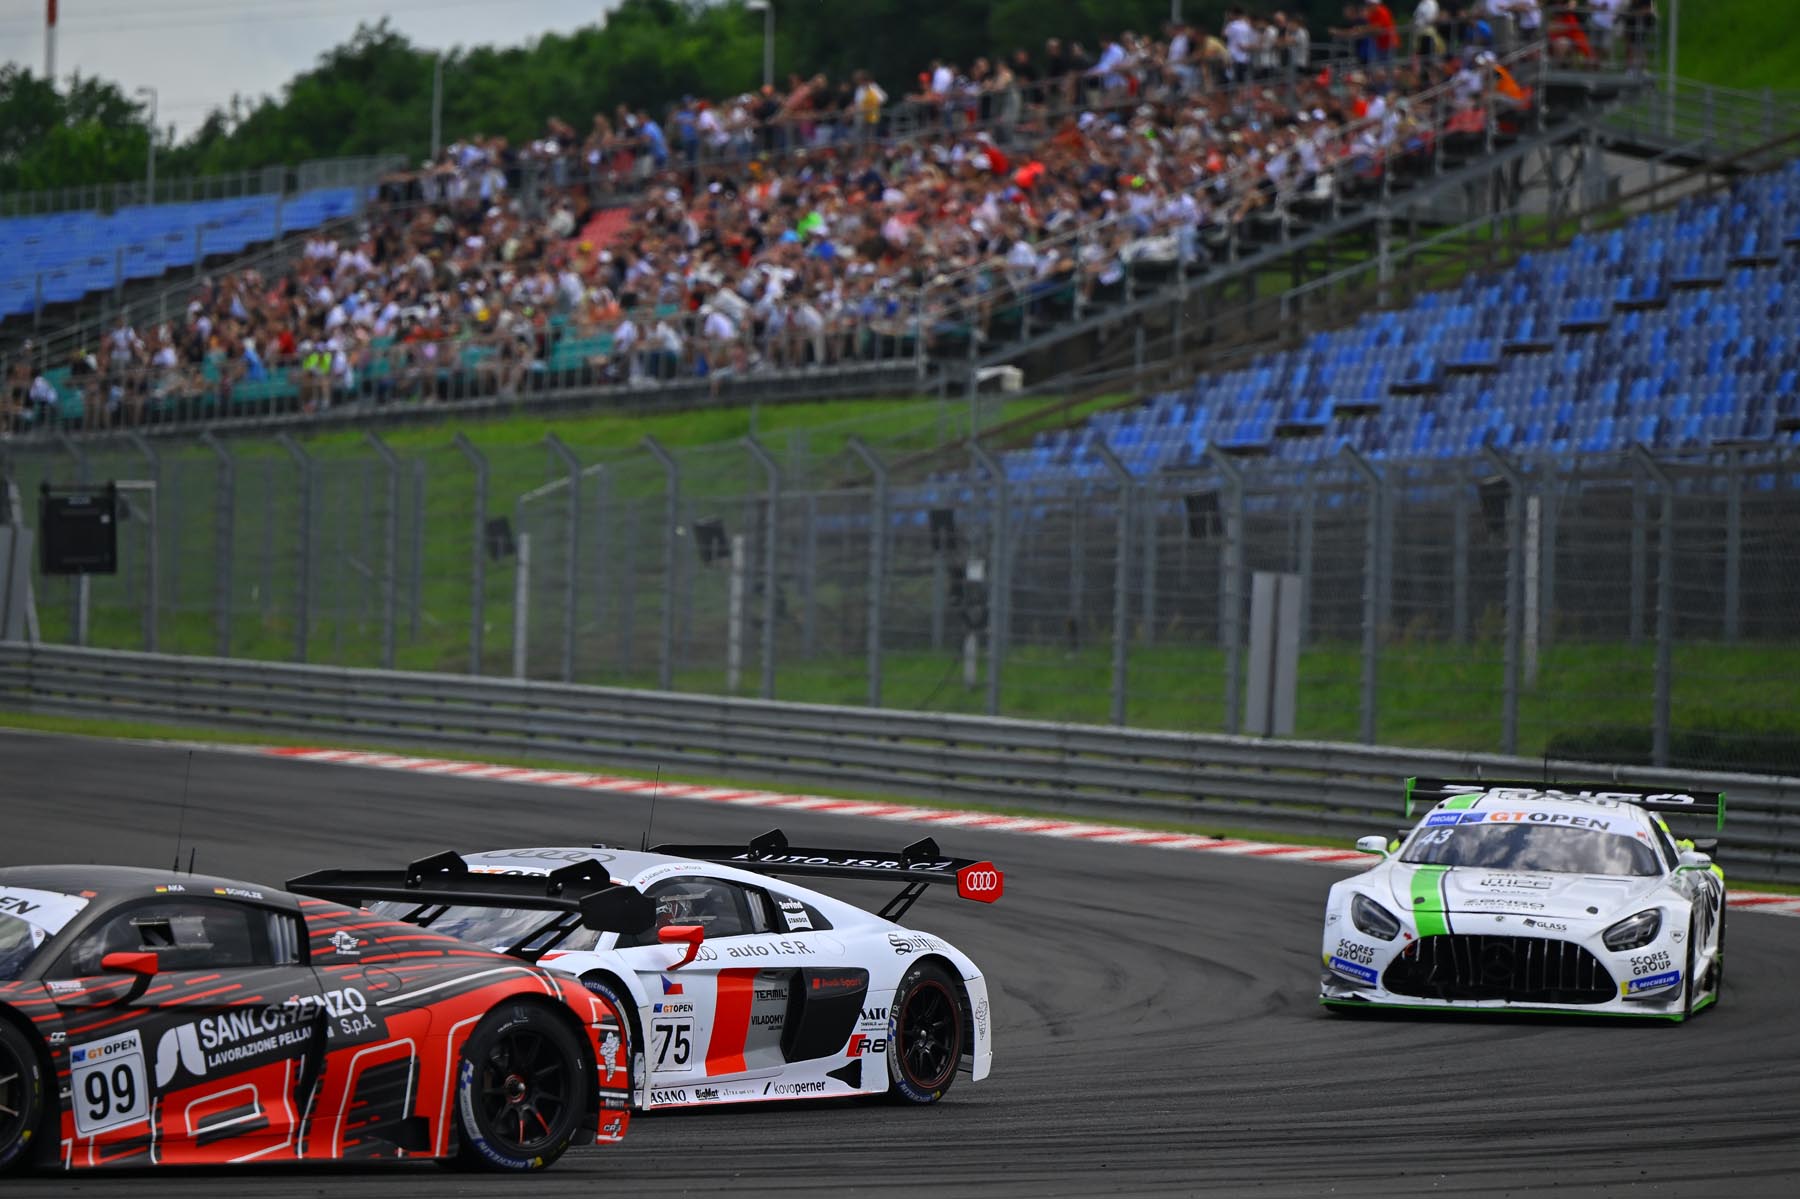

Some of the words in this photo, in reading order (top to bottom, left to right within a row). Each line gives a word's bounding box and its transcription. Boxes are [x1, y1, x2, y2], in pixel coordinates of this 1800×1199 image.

[1536, 921, 1567, 931] GLASS
[727, 944, 769, 958] auto
[770, 940, 816, 955] I.S.R.
[1338, 938, 1375, 956] SCORES
[1336, 948, 1373, 966] GROUP
[1630, 950, 1670, 966] SCORES
[1336, 963, 1372, 978] MICHELIN
[1633, 960, 1671, 976] GROUP
[1639, 976, 1676, 988] MICHELIN
[199, 988, 367, 1049] SANLORENZO
[751, 1014, 784, 1025] VILADOMY
[208, 1036, 278, 1068] LAVORAZIONE
[655, 1024, 691, 1065] 75
[855, 1038, 887, 1054] R8
[84, 1063, 136, 1121] 99
[773, 1080, 826, 1096] kovoperner
